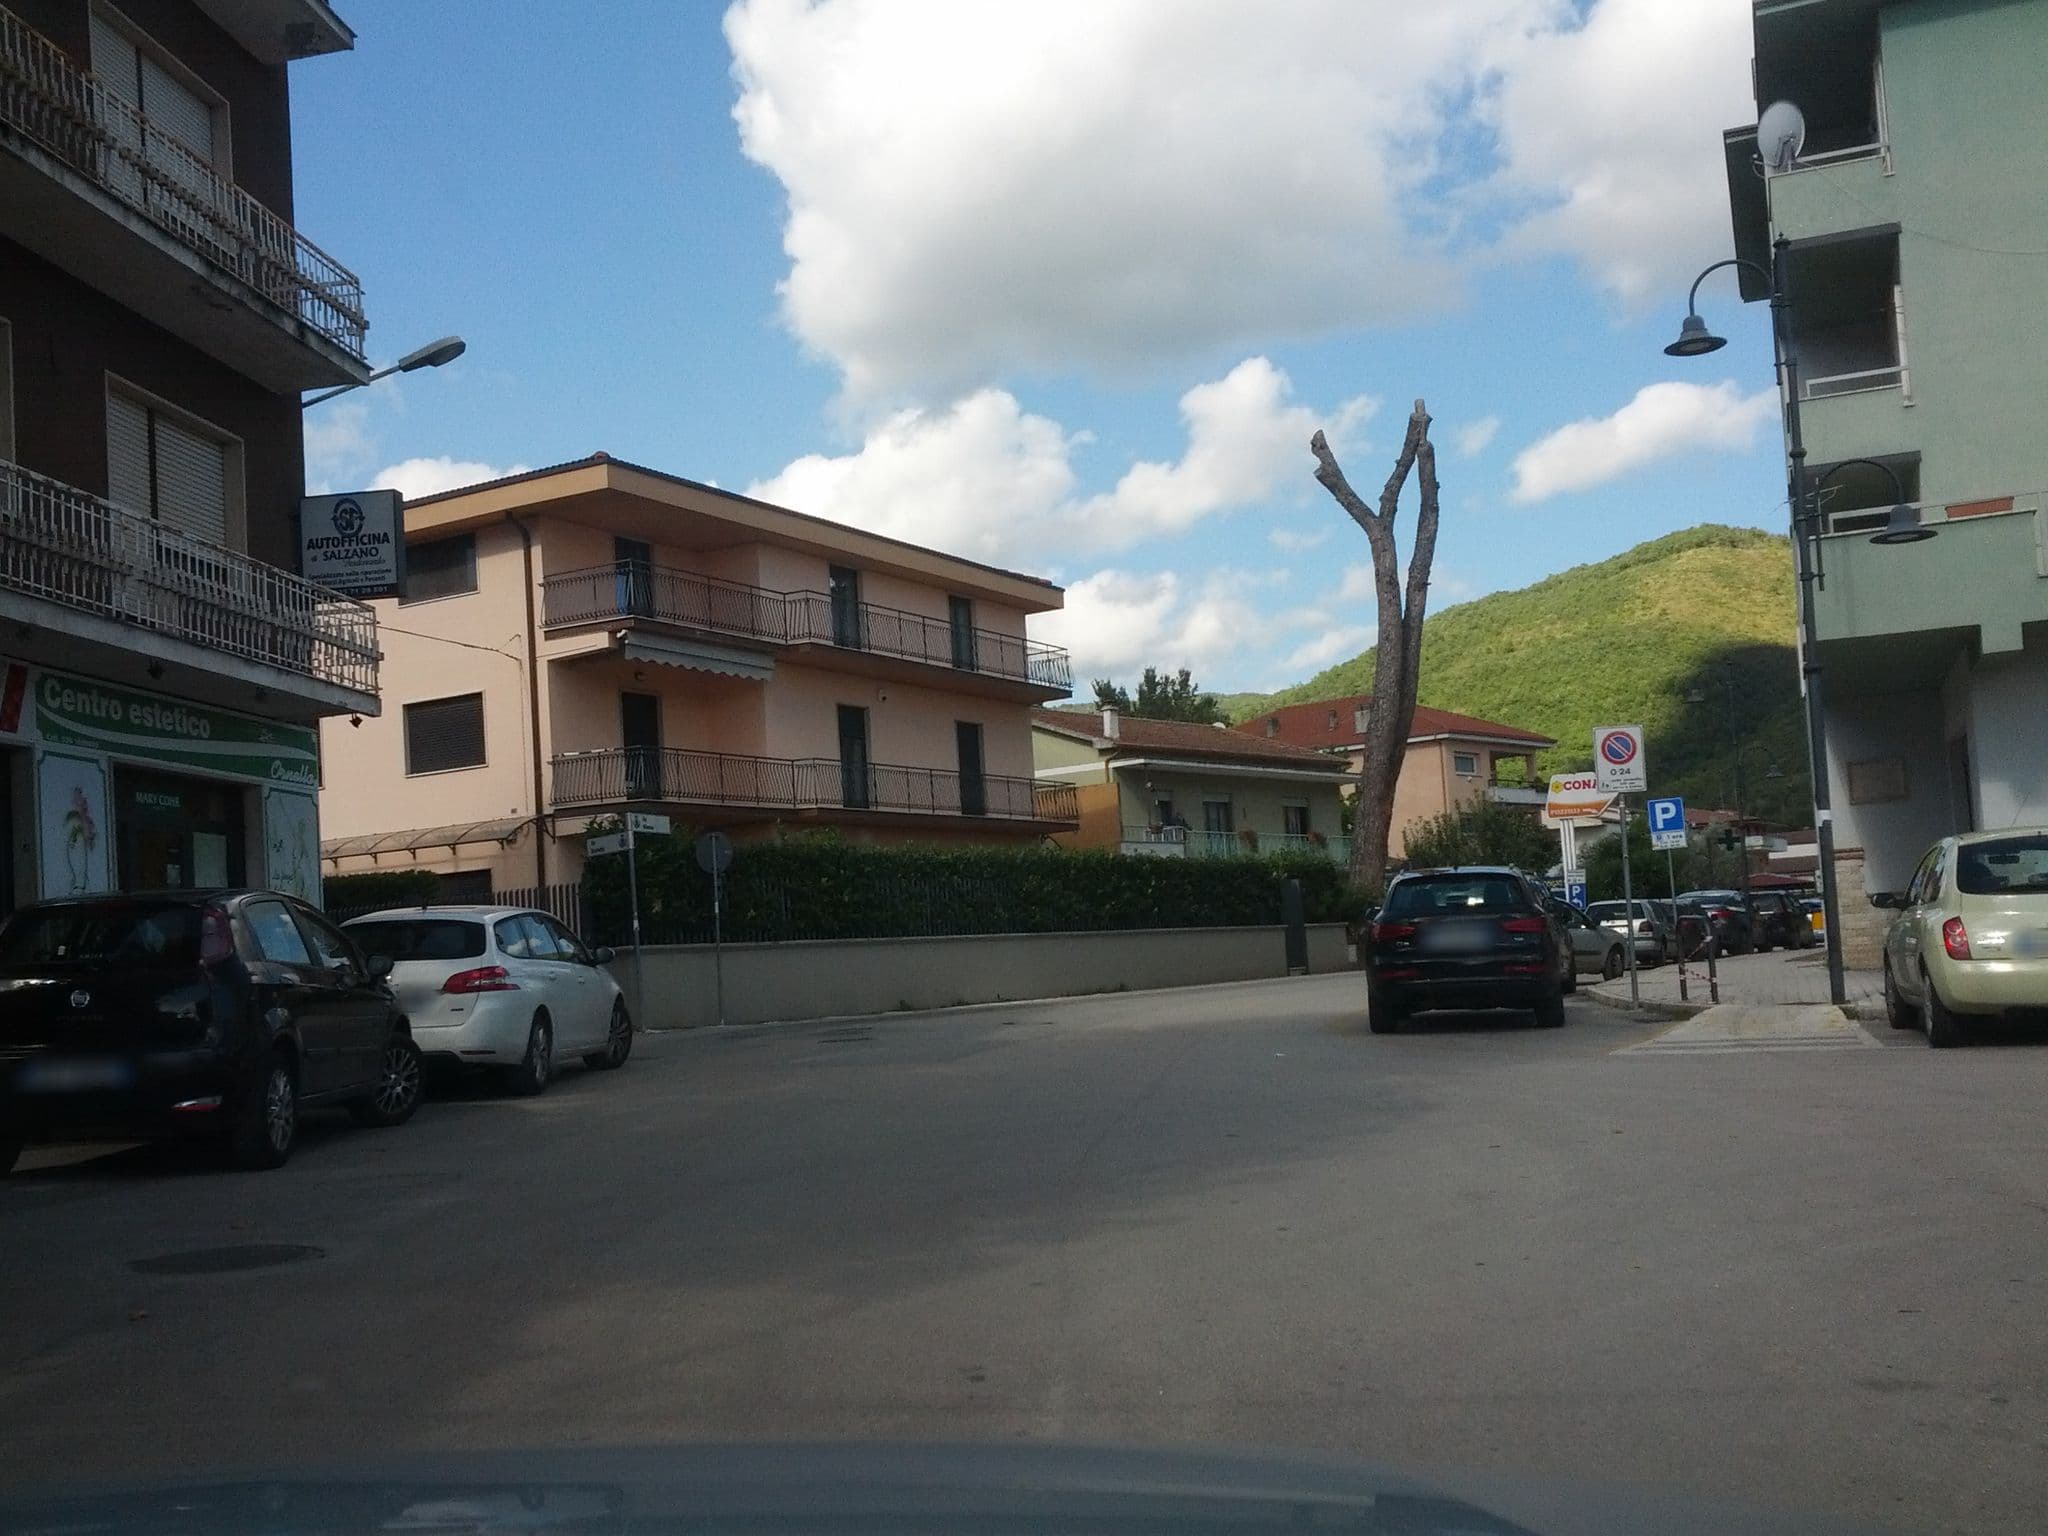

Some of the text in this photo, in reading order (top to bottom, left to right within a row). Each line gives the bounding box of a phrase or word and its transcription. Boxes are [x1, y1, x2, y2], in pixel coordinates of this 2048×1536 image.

[307, 532, 390, 550] AUTOFFICINA
[323, 546, 379, 561] SALZANO
[44, 678, 210, 739] Centro estetico
[271, 760, 314, 784] Ornella
[1655, 802, 1676, 829] P
[1572, 885, 1581, 897] P
